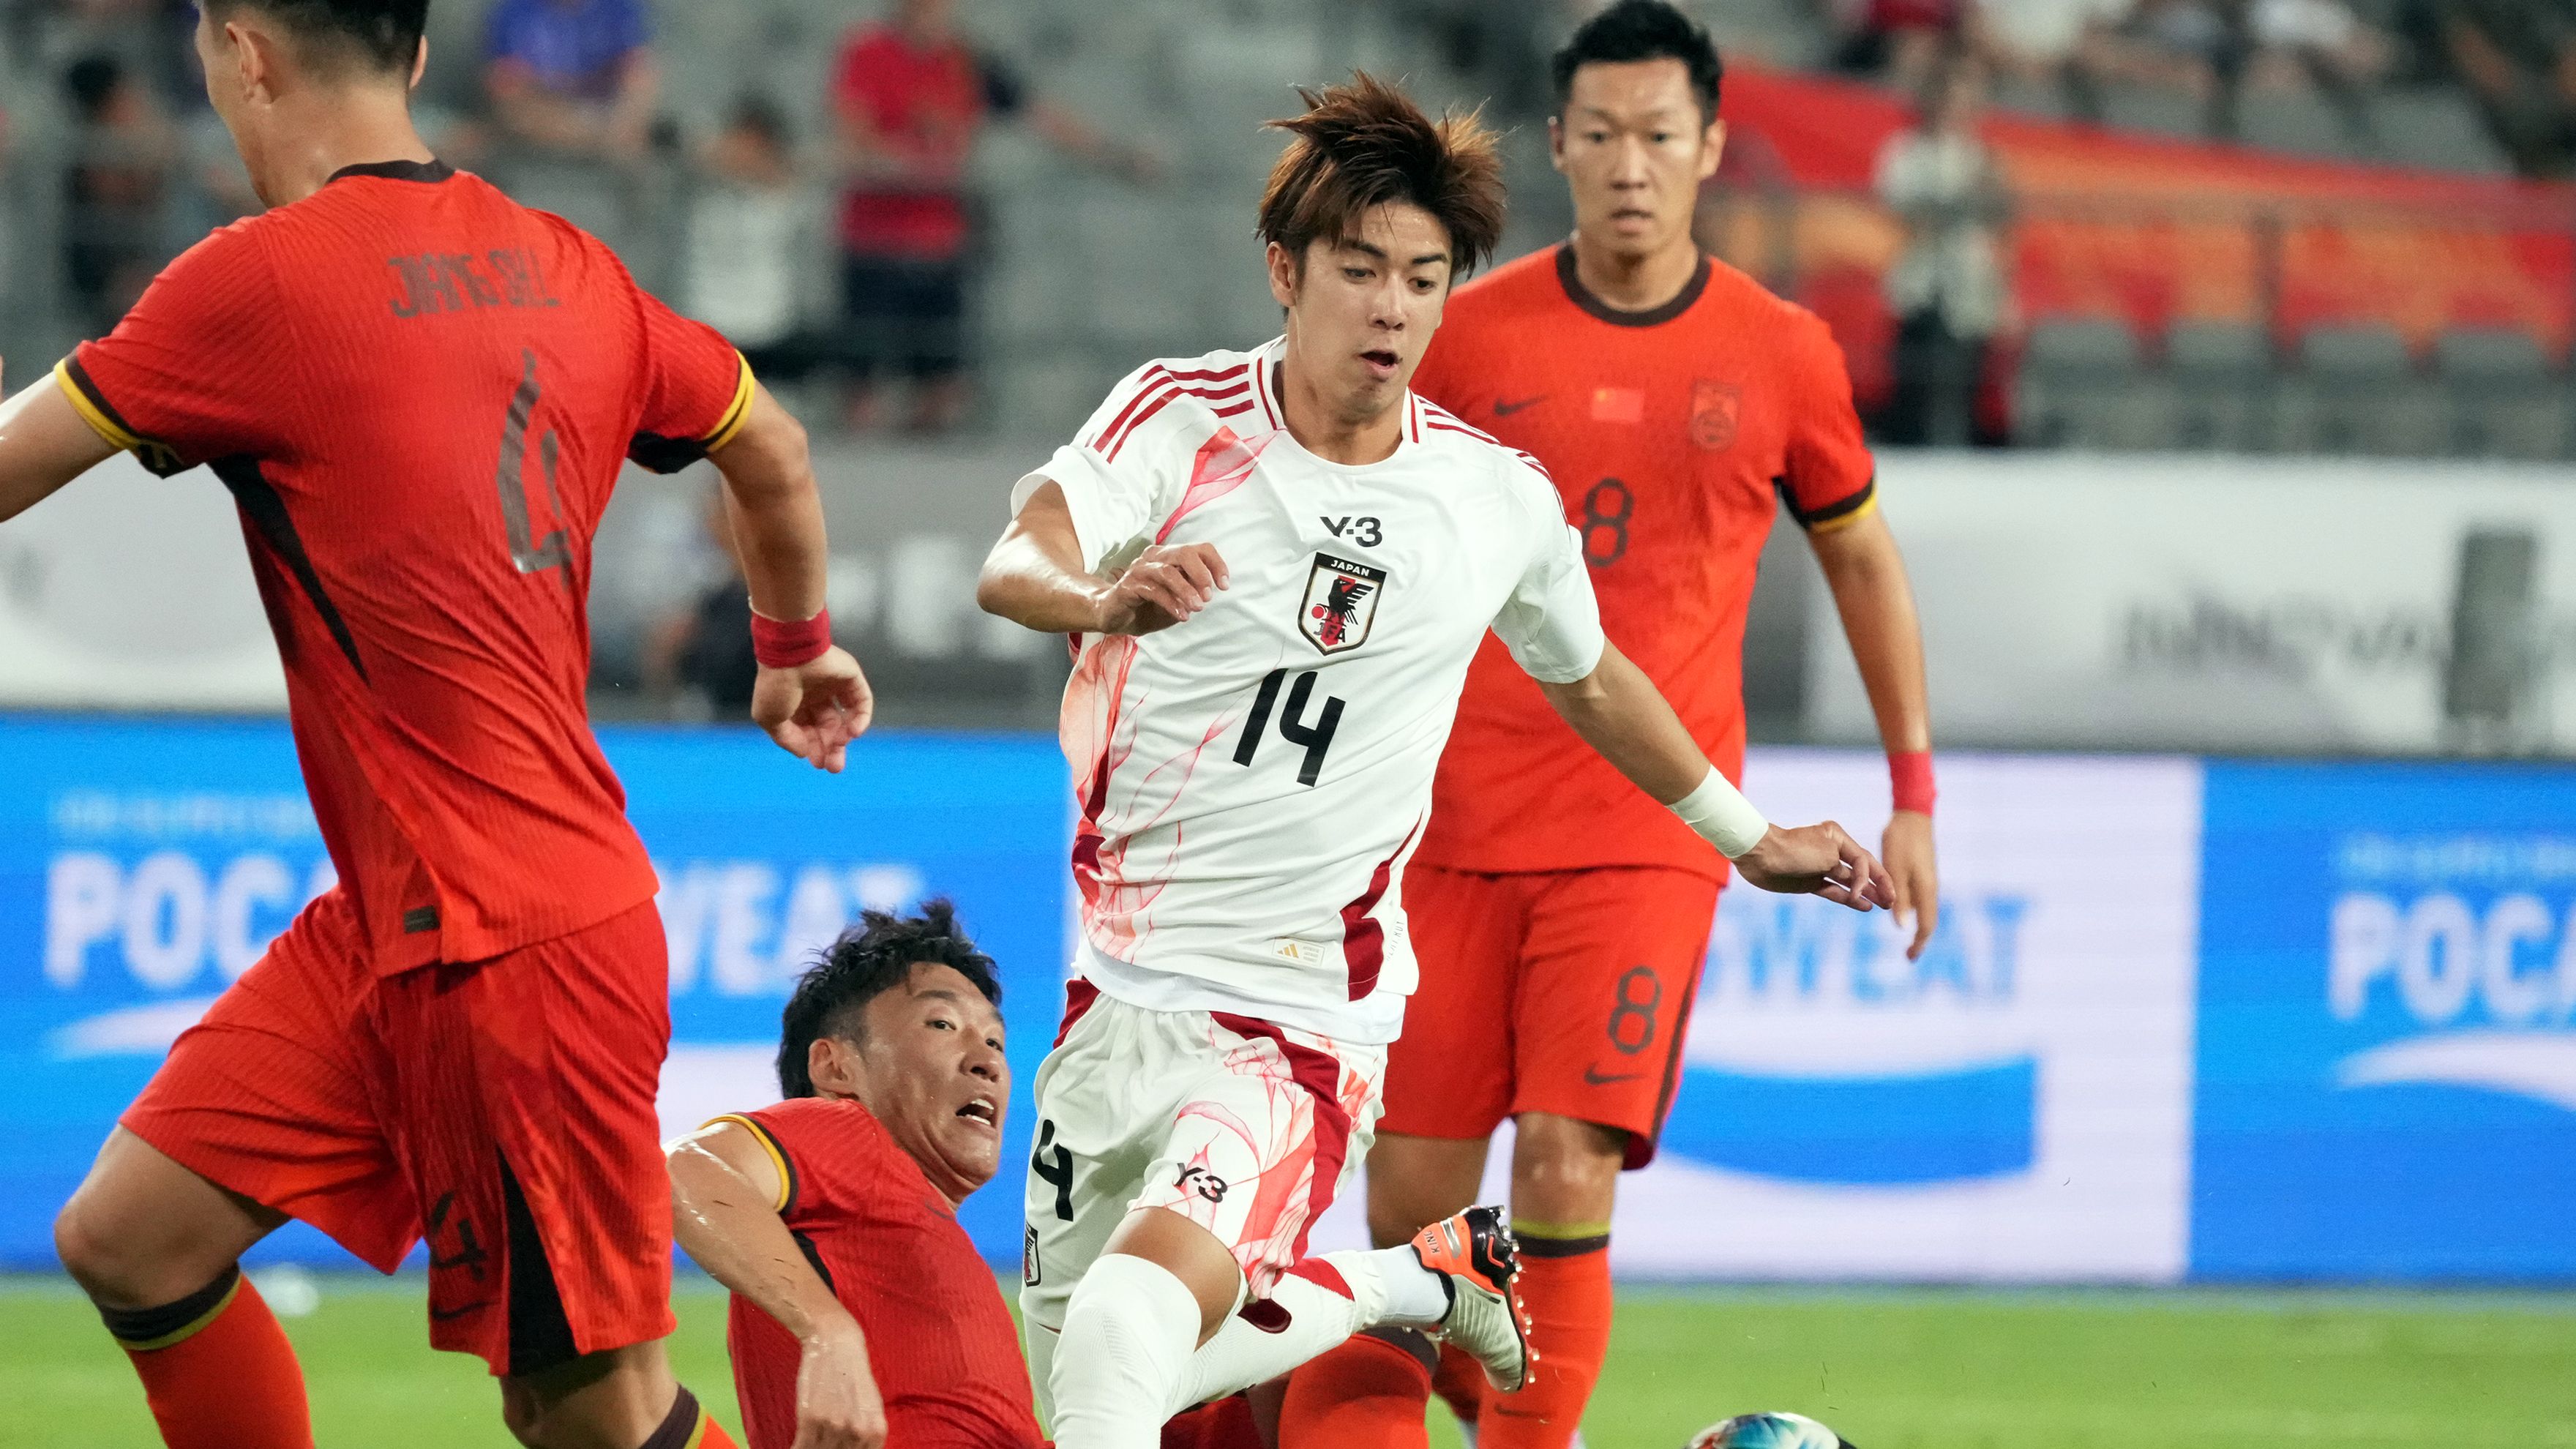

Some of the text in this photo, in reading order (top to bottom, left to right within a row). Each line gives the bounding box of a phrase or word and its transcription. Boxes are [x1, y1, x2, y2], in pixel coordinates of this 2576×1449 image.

[495, 347, 573, 594] 4
[1319, 517, 1382, 547] Y-3
[1330, 559, 1370, 577] JAPAN
[1581, 477, 1634, 568] 8
[1314, 622, 1345, 643] JFA
[1232, 668, 1347, 787] 14
[45, 851, 340, 989] POC
[2329, 893, 2576, 1020] POC
[1607, 965, 1663, 1055] 8
[1172, 1162, 1228, 1203] Y-3
[430, 1189, 488, 1281] 4
